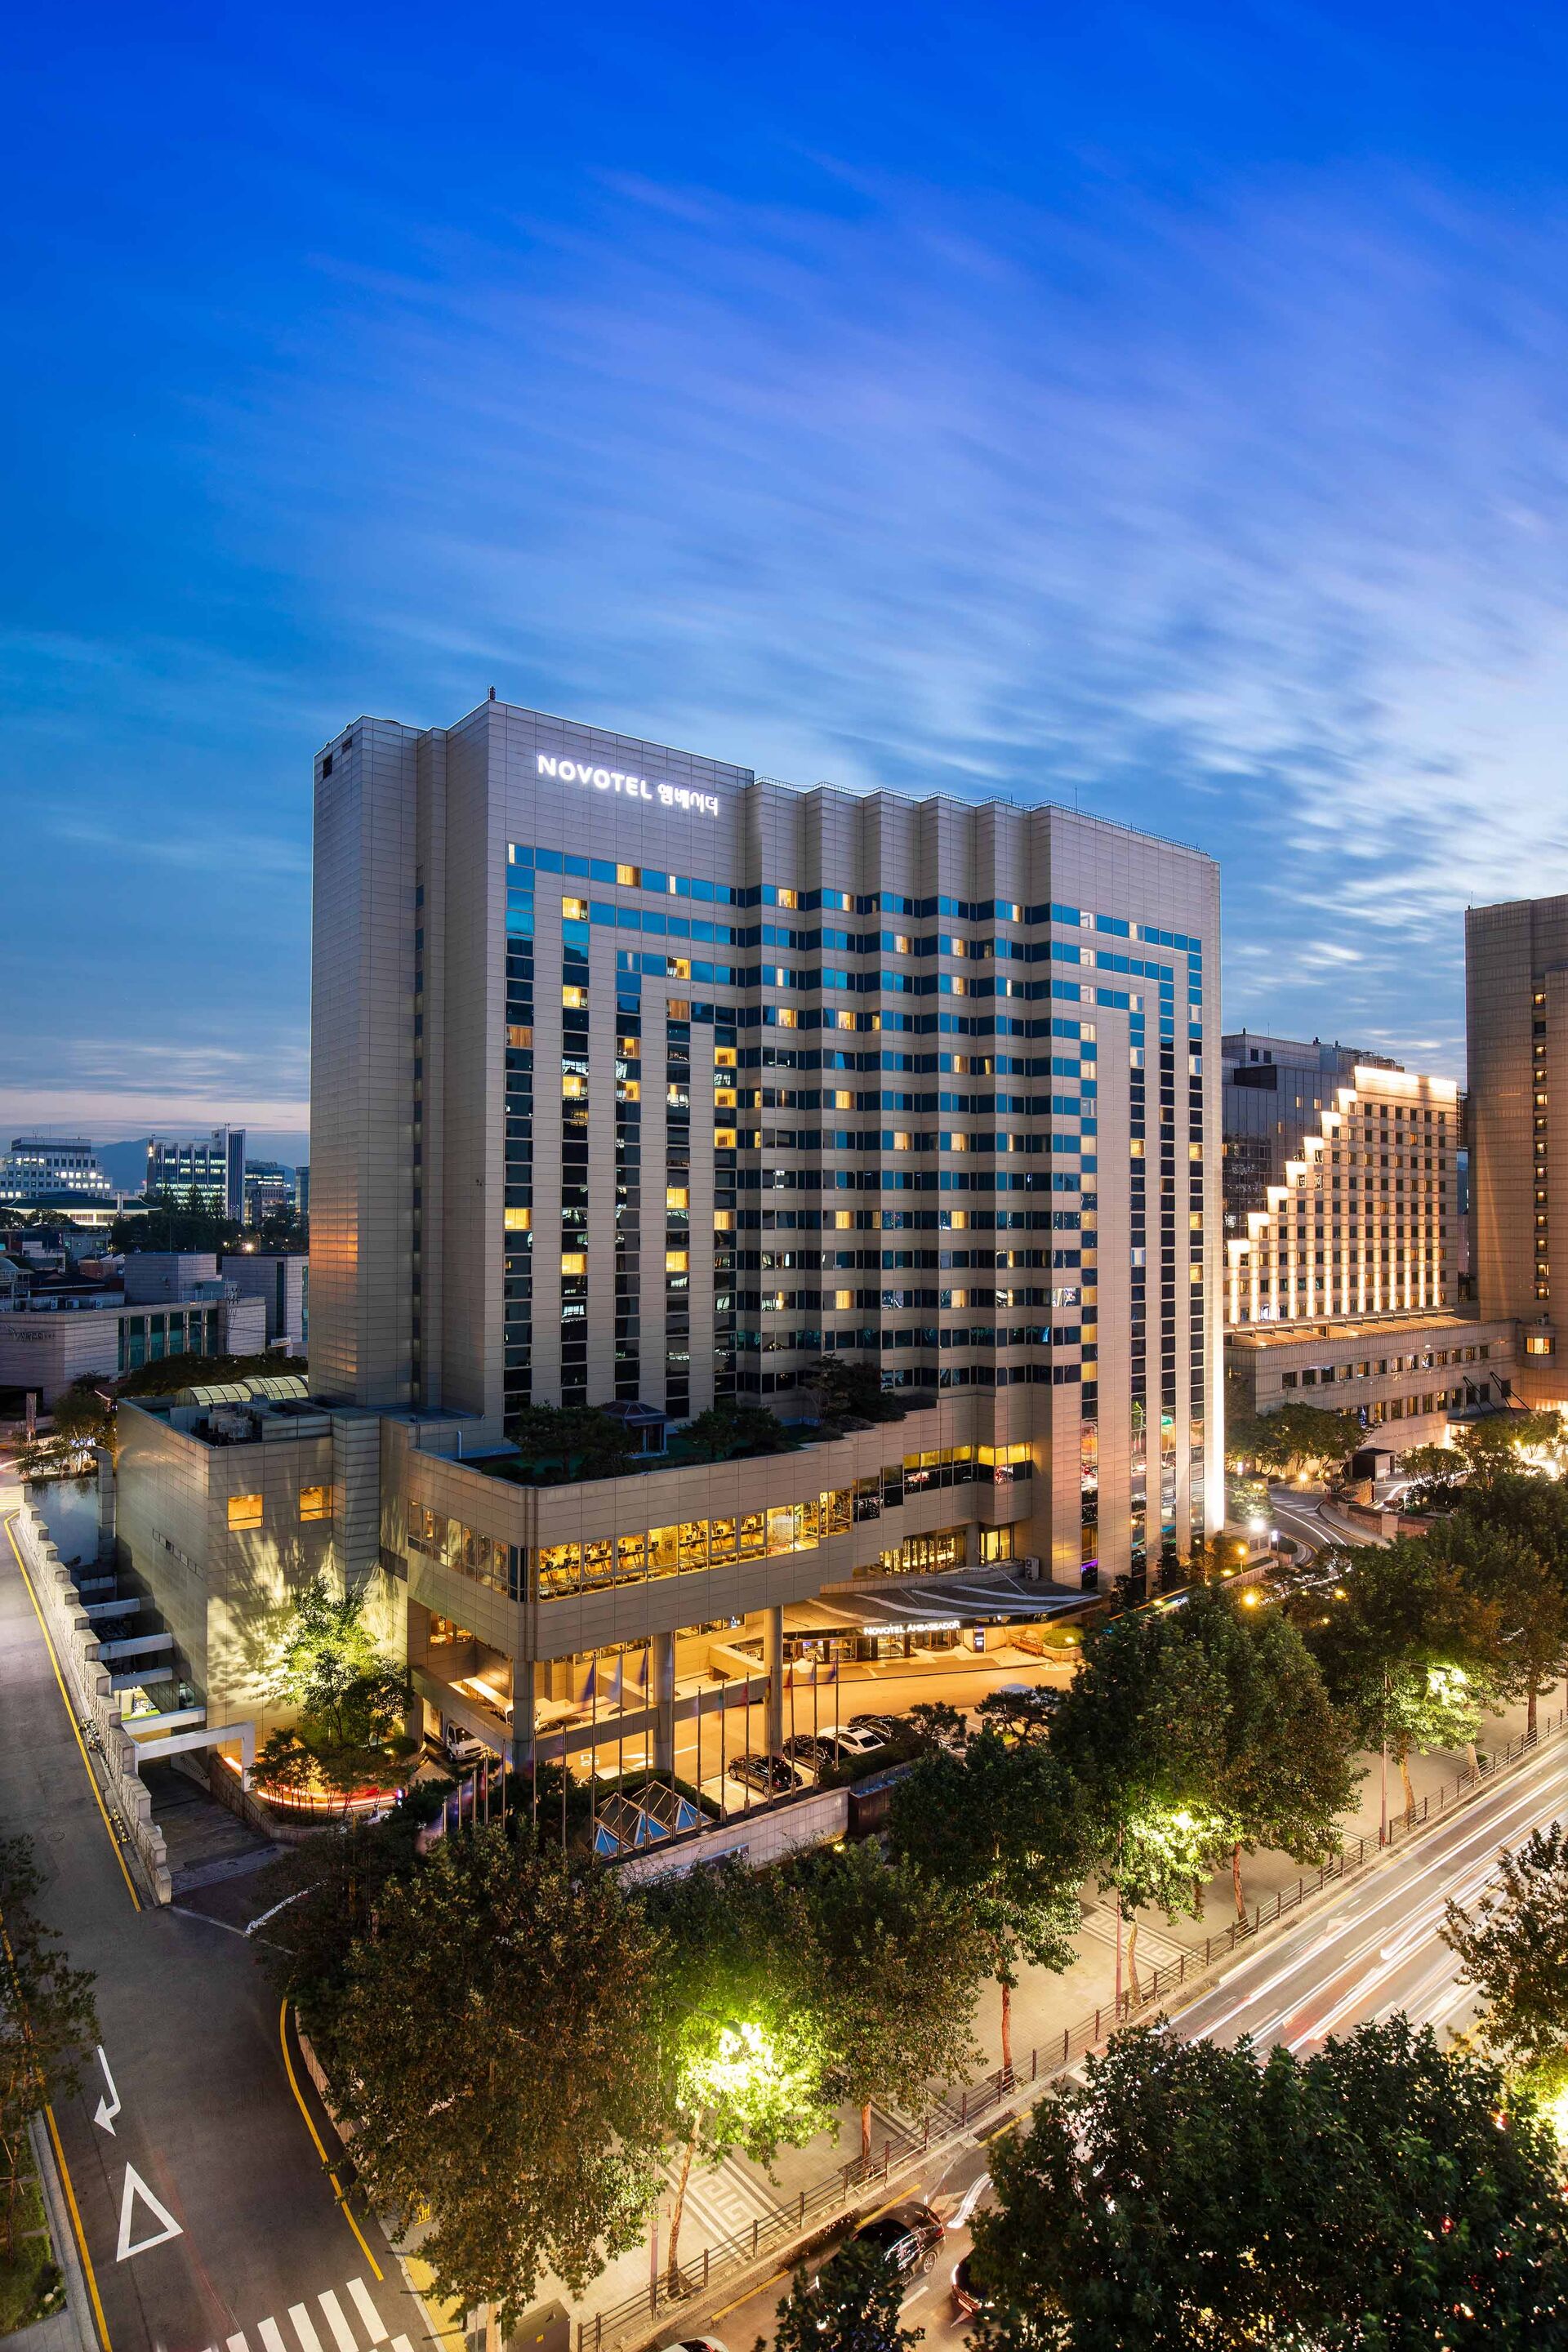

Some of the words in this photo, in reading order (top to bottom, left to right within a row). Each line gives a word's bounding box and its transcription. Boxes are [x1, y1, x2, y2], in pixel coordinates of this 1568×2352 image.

[537, 754, 653, 800] NOVOTEL
[863, 1624, 906, 1636] NOVOTEL
[906, 1620, 961, 1633] AMBASSADOR
